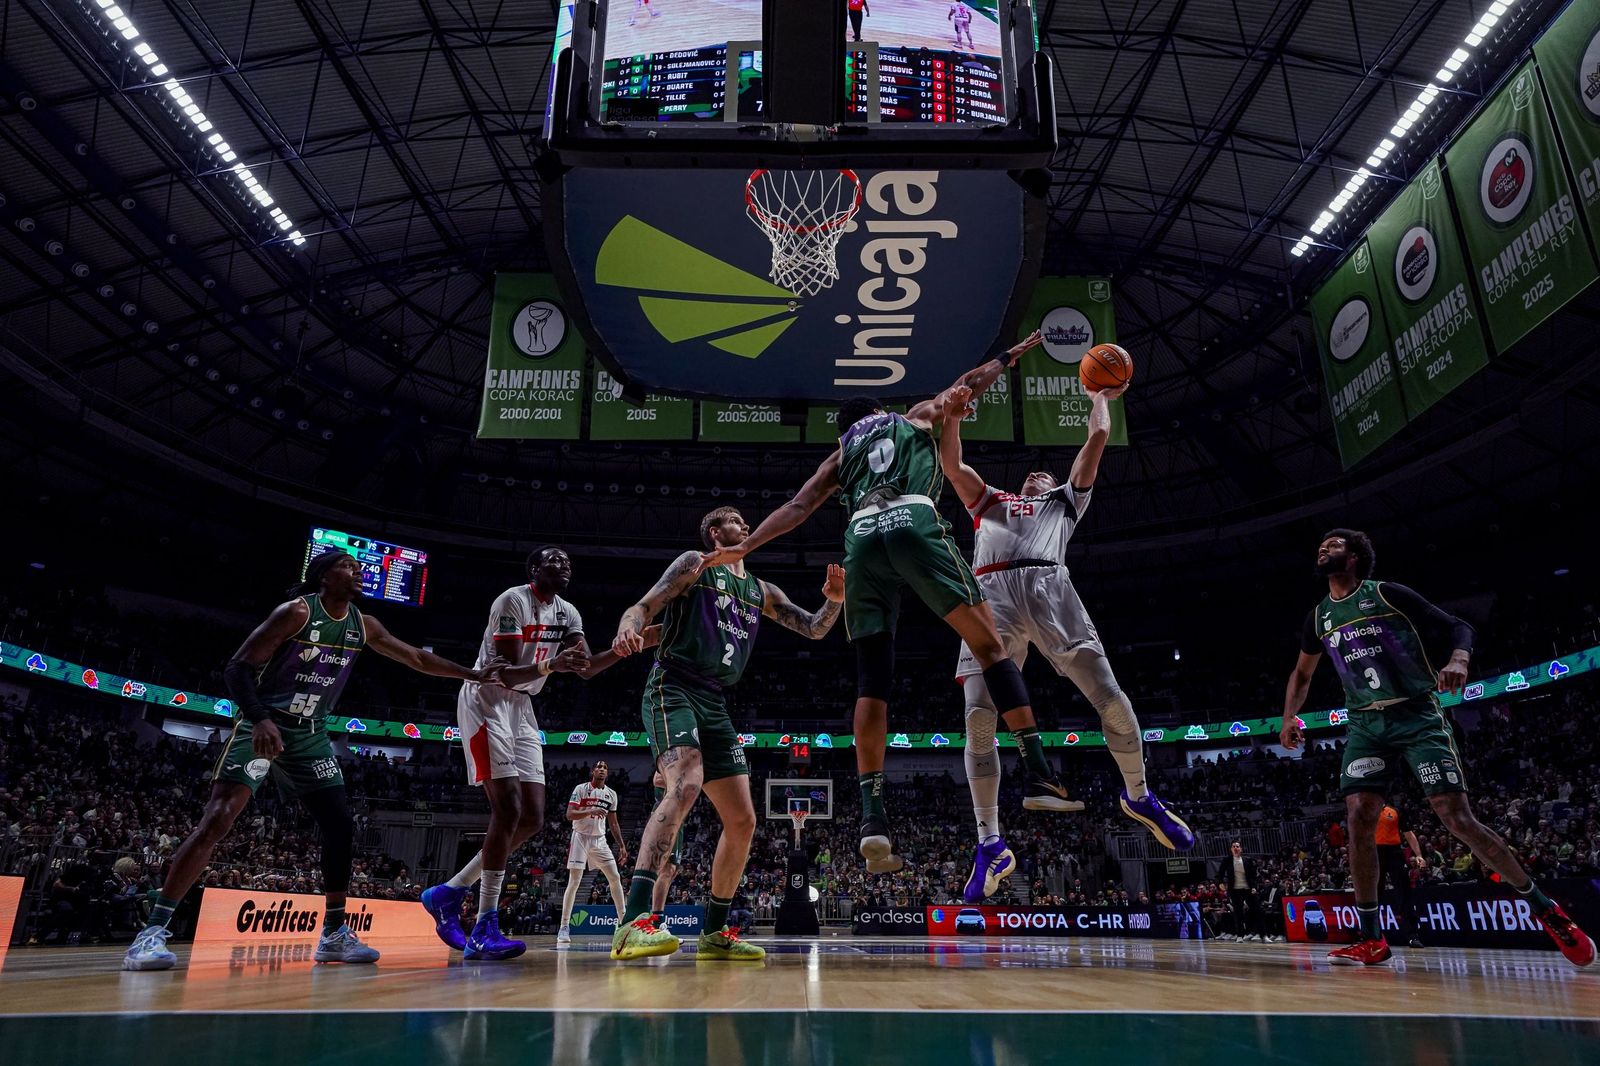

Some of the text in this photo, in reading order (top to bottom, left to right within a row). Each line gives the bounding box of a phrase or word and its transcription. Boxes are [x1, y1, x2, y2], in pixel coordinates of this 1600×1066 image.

[878, 54, 908, 63] USSELLE
[878, 64, 913, 75] LIBEGOVIC
[879, 75, 896, 84] OSTA
[879, 85, 898, 94] URÁN
[880, 95, 898, 105] OMÀS
[664, 104, 688, 112] PERRY
[880, 107, 896, 115] ÉREZ
[1481, 194, 1574, 292] CAMPEONES
[1488, 225, 1576, 305] COPA DEL REY
[834, 170, 958, 386] Unicaja
[1522, 274, 1554, 310] 2025
[1394, 283, 1468, 361] CAMPEONES
[1400, 308, 1473, 375] SUPERCOPA
[1426, 351, 1454, 380] 2024
[487, 369, 580, 390] CAMPEONES
[1025, 376, 1083, 395] CAMPE
[1332, 351, 1391, 416] CAMPEONES
[490, 389, 575, 401] COPA KORAC
[983, 394, 1008, 404] REY
[500, 408, 562, 420] 2000/2001
[1061, 401, 1088, 412] BCL
[626, 409, 657, 420] 2005
[717, 410, 781, 423] 2005/2006
[1058, 415, 1089, 427] 2024
[1357, 410, 1380, 436] 2024
[868, 438, 895, 474] 0
[878, 508, 912, 521] COSTA
[894, 515, 912, 524] SOL
[368, 542, 377, 550] VS
[384, 546, 390, 554] 3
[360, 563, 380, 573] 7:40
[717, 619, 749, 640] málaga
[1343, 624, 1382, 642] Unicaja
[319, 653, 350, 668] Unicaj
[721, 642, 734, 666] 2
[1344, 644, 1382, 664] málaga
[295, 672, 336, 686] málaga
[1363, 667, 1381, 690] 3
[288, 692, 321, 716] 55
[792, 745, 808, 757] 14
[1420, 773, 1442, 785] laga
[236, 899, 318, 933] Gráficas
[589, 914, 619, 926] Unica
[860, 908, 924, 924] endesa
[997, 913, 1150, 929] TOYOTA C-HR HYBRID
[1332, 900, 1544, 931] TOYTA -HR HYBR
